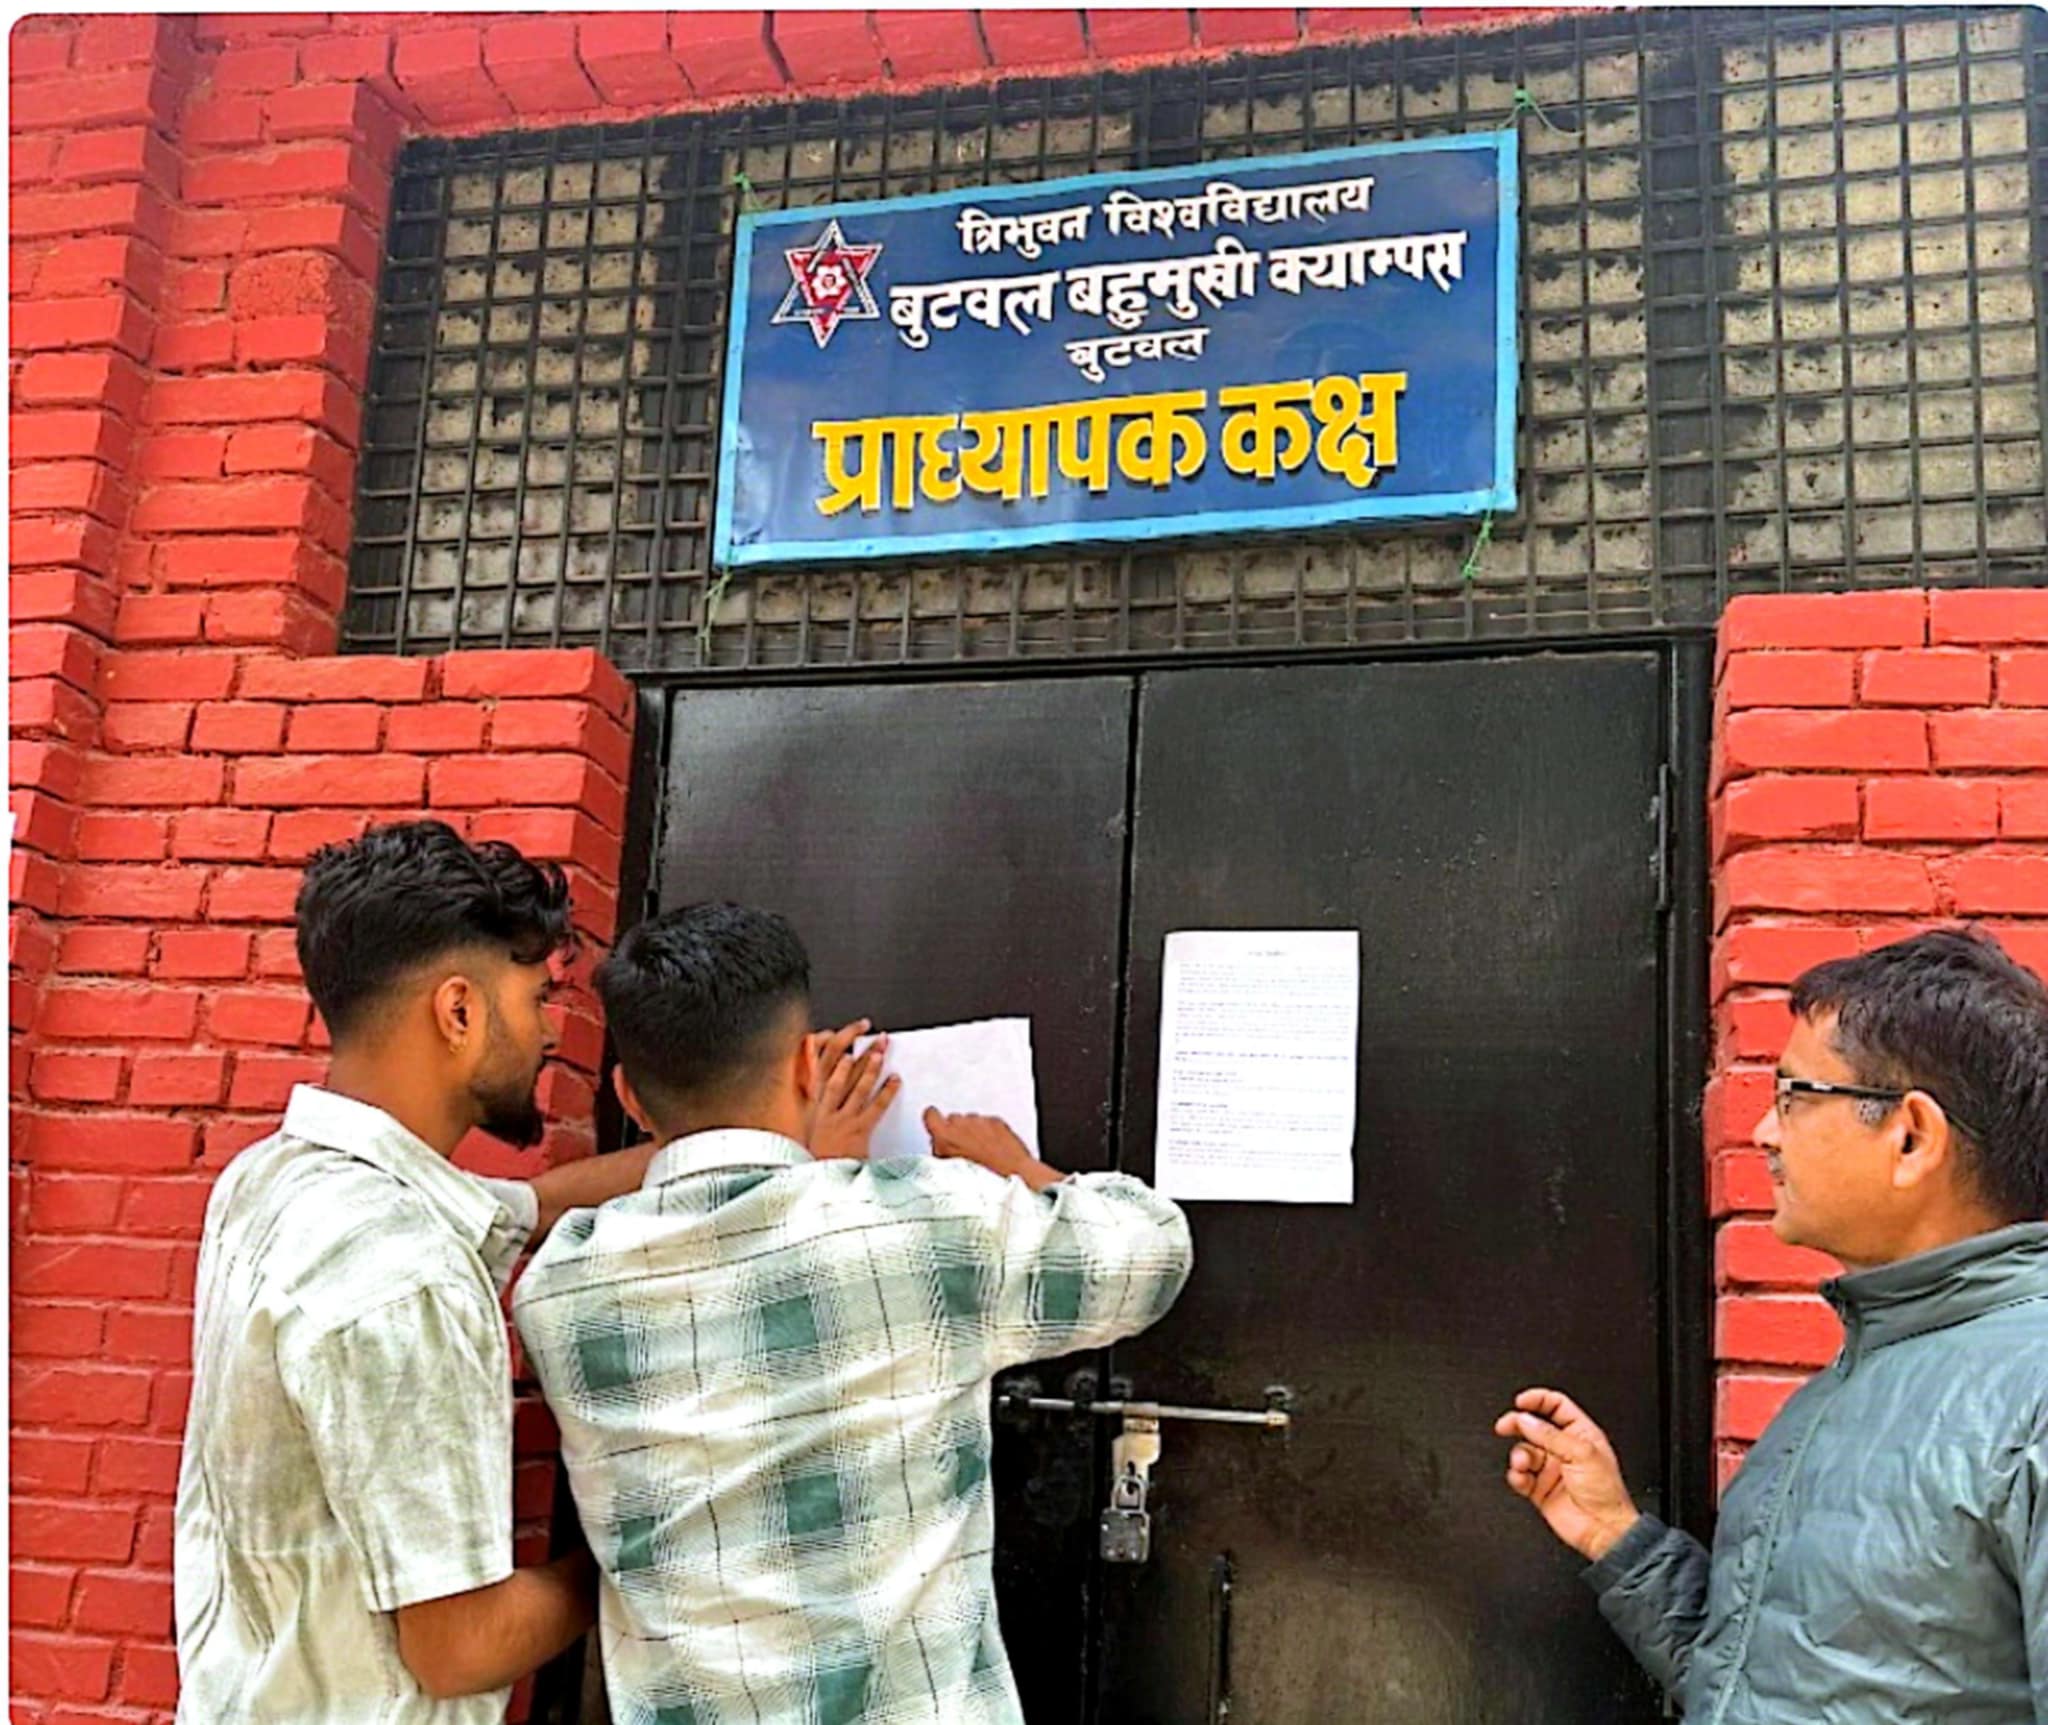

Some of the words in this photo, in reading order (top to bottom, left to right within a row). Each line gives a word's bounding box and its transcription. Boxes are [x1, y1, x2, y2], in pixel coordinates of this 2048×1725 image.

[956, 208, 1092, 259] त्रिभुवन
[1103, 177, 1375, 238] विश्वविद्यालय
[889, 270, 1060, 348] बुटवल
[1065, 235, 1260, 329] बहुमुखी
[1268, 231, 1467, 293] क्याम्पस
[1065, 328, 1210, 383] बुटवल
[1219, 371, 1407, 489] कक्ष
